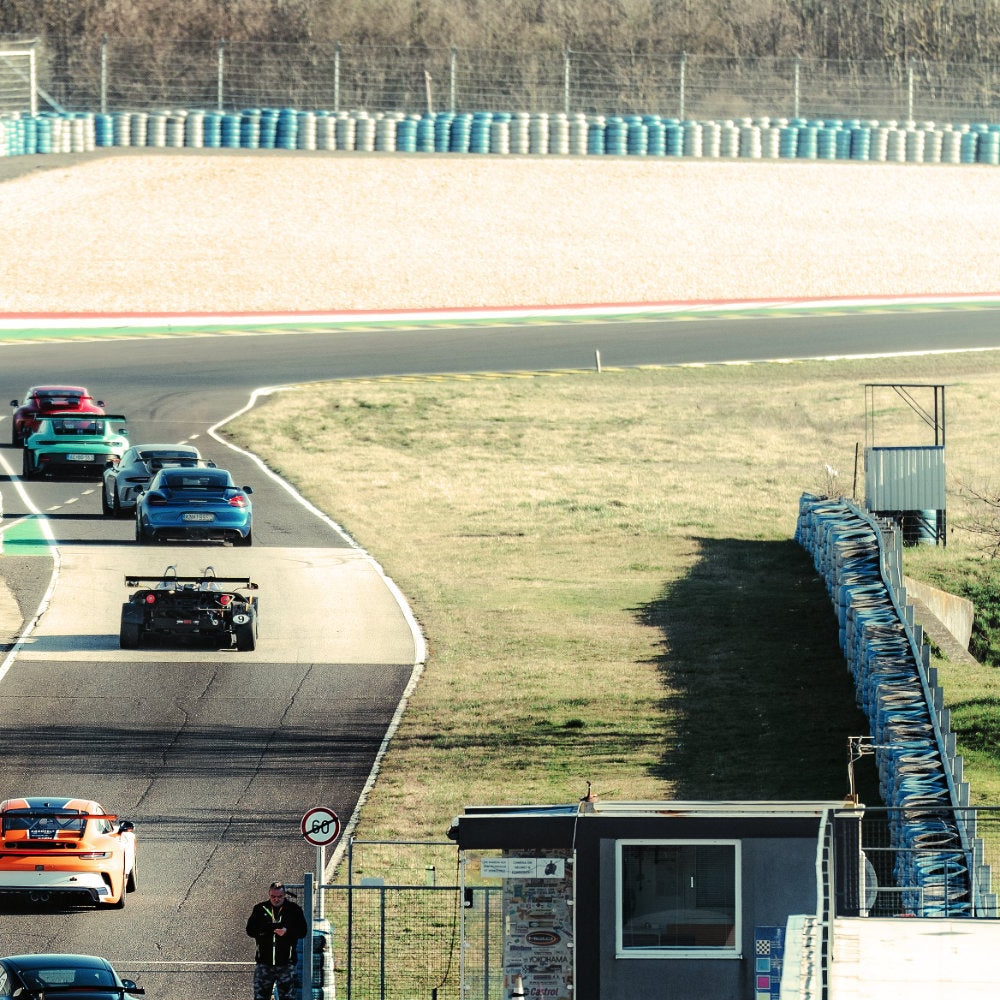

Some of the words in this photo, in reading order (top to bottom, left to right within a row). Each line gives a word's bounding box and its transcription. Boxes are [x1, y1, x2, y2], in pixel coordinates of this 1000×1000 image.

[312, 819, 329, 834] 60
[529, 955, 568, 963] YOKOHAMA
[530, 987, 559, 997] Castrol
